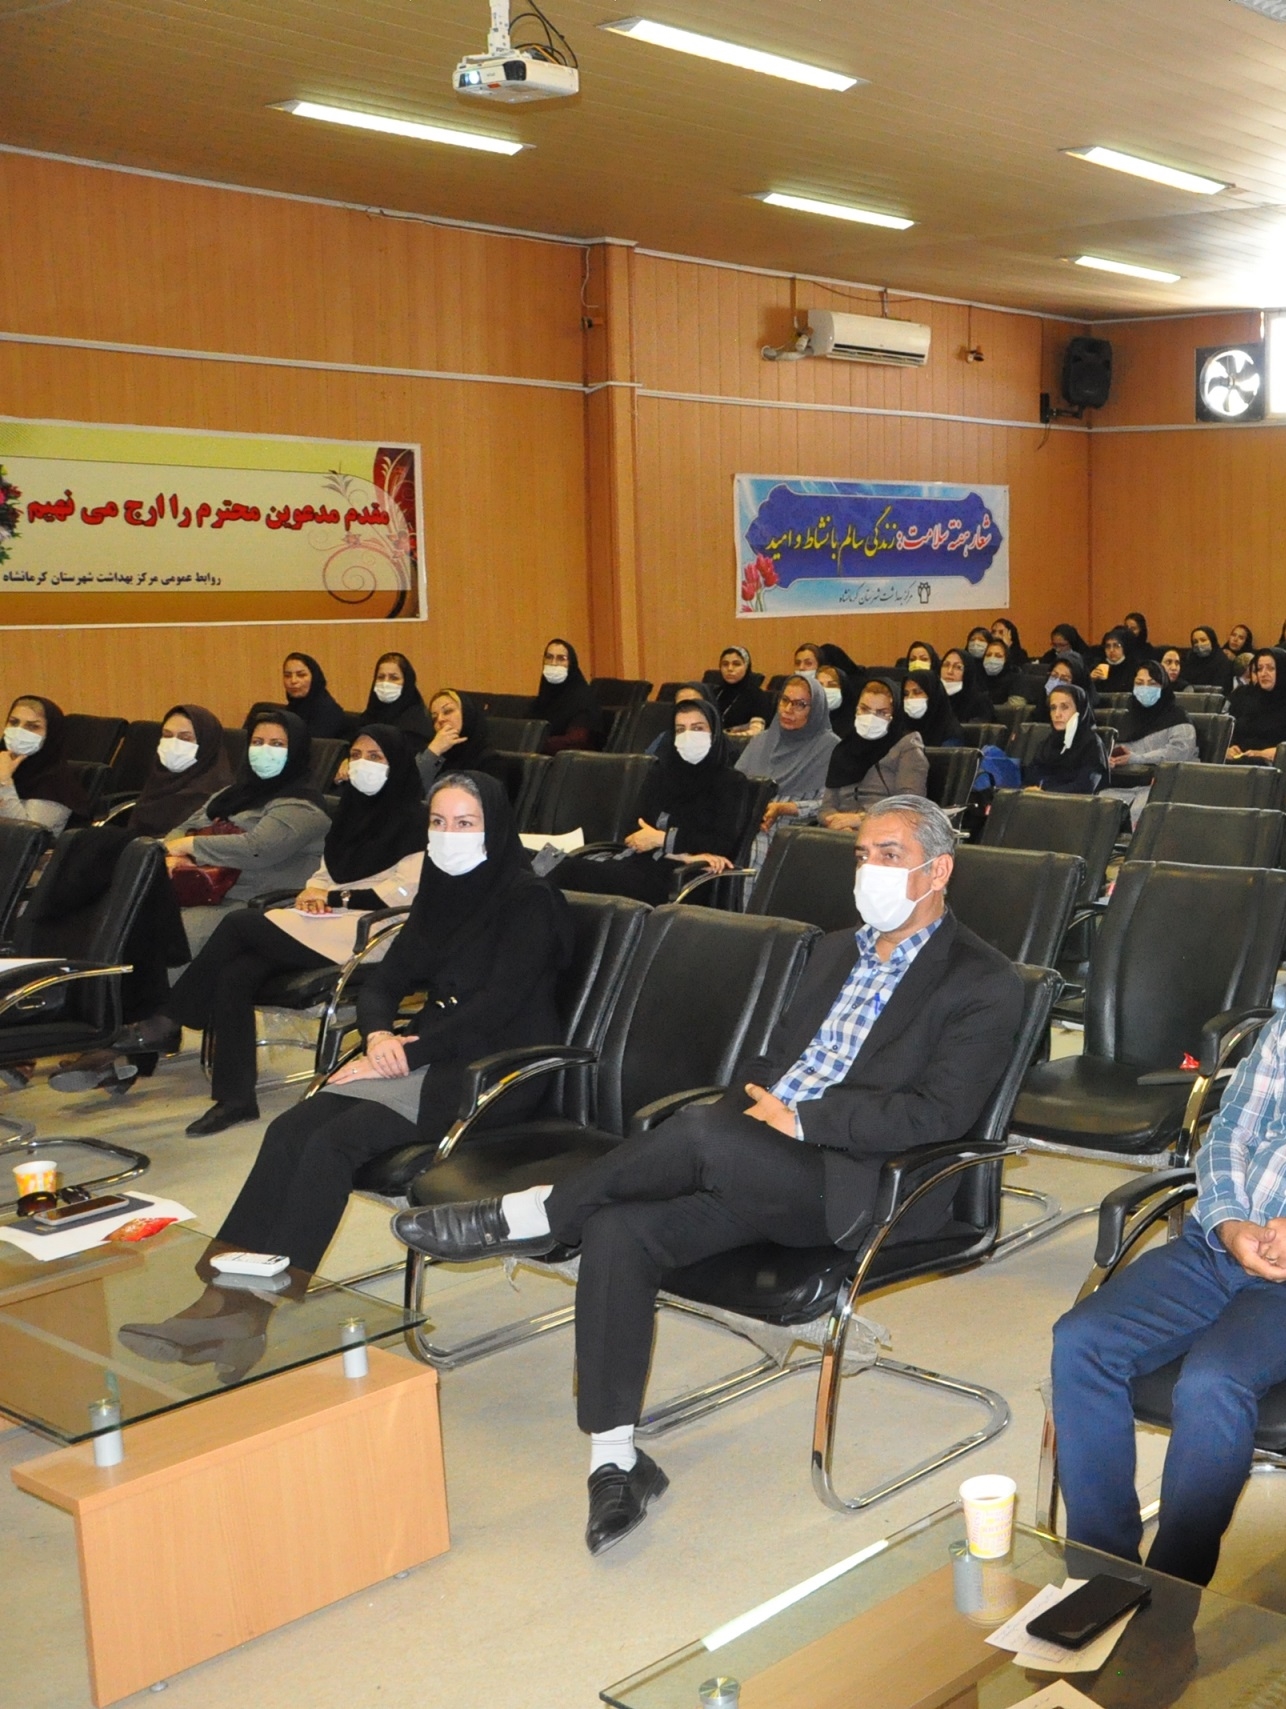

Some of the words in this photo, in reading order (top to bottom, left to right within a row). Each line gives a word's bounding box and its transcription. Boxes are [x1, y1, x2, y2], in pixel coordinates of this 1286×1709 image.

[80, 500, 119, 525] می
[123, 492, 165, 527] ارج
[169, 493, 192, 528] را
[195, 499, 262, 529] محترم
[265, 504, 341, 530] مدعوین
[343, 502, 390, 532] مقدم
[864, 505, 897, 557] زندگی
[967, 513, 992, 550] شعار
[765, 529, 792, 560] امید
[3, 571, 47, 586] کرمانشاه
[51, 571, 94, 586] شهرستان
[96, 571, 133, 586] بهداشت
[136, 572, 158, 586] مرکز
[161, 572, 192, 586] عمومی
[194, 572, 221, 586] روابط
